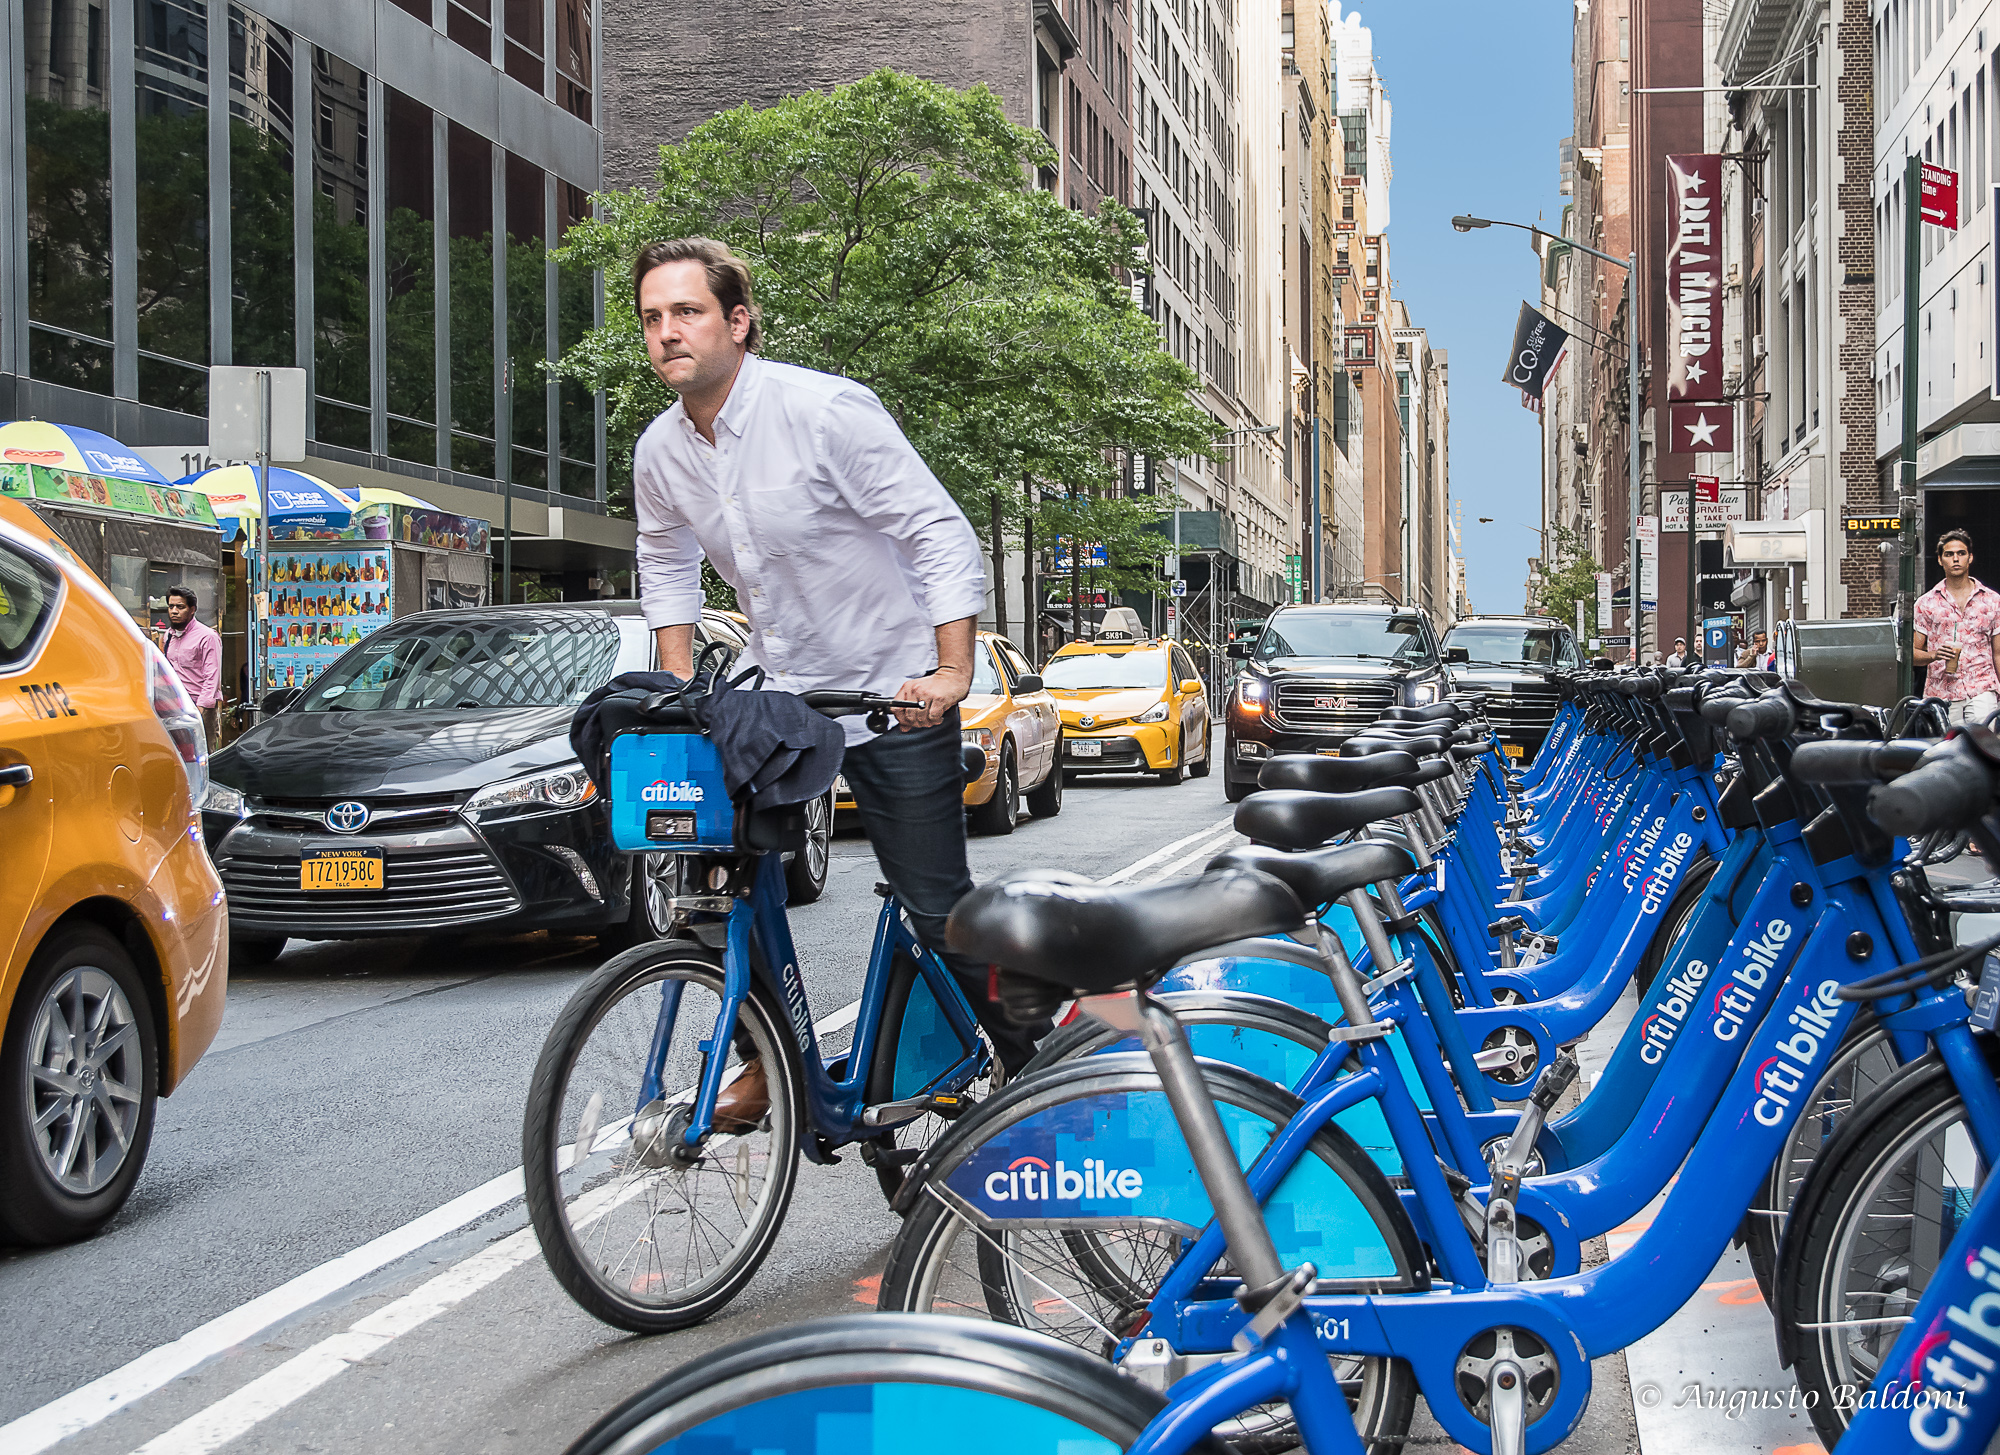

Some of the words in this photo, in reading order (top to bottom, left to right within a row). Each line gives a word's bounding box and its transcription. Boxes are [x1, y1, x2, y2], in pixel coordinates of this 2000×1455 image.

[1921, 167, 1952, 187] STANDING
[1679, 250, 1710, 266] A
[1679, 272, 1712, 358] MANGER
[1512, 349, 1538, 384] CQ
[285, 490, 323, 501] Lyca
[293, 498, 327, 506] mobile
[1760, 540, 1782, 556] 62
[1714, 601, 1726, 610] 56
[1105, 632, 1123, 640] 5K81
[1712, 630, 1723, 646] P
[1314, 697, 1359, 709] GMC
[308, 860, 374, 882] T721958C
[1653, 832, 1692, 880] bike
[1641, 875, 1670, 914] citi
[1732, 918, 1792, 990] bike
[1656, 959, 1708, 1022] bike
[1713, 982, 1756, 1041] citi
[1775, 979, 1844, 1066] bike
[1640, 1014, 1678, 1065] citi
[1753, 1056, 1804, 1127] citi
[984, 1156, 1050, 1201] citi
[1055, 1158, 1143, 1200] bike
[1908, 1330, 1997, 1450] citi
